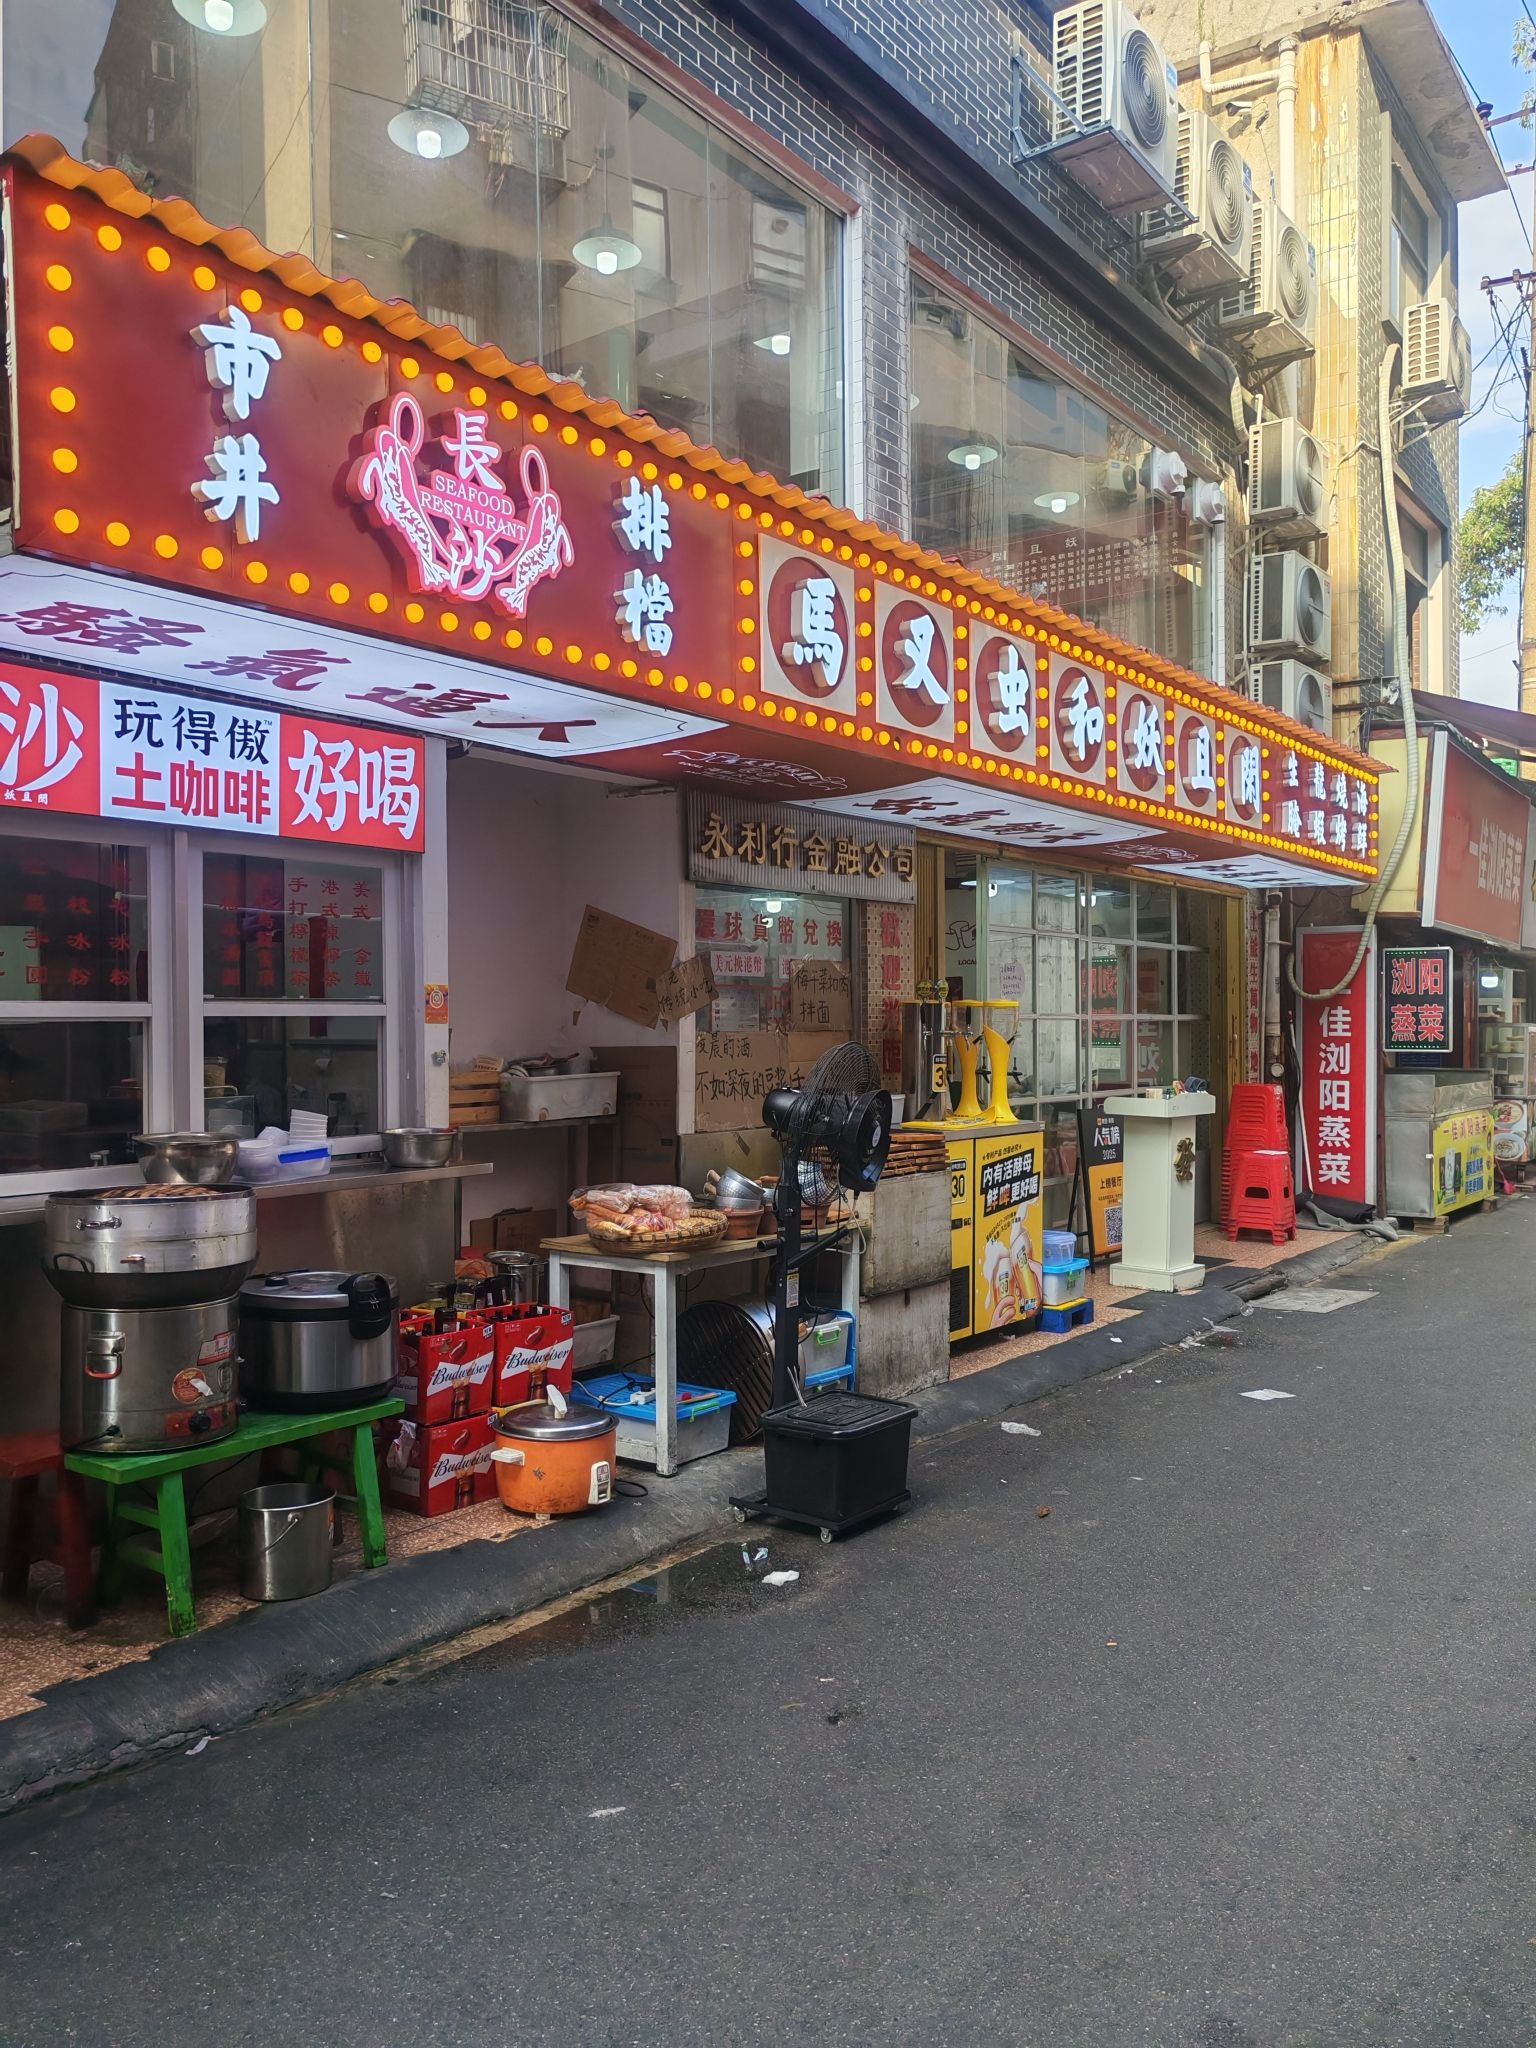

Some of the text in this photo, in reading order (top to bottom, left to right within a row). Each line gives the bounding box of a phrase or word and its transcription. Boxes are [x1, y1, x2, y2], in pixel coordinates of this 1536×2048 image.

[191, 305, 281, 542] 市井
[446, 412, 503, 489] 長
[435, 475, 513, 515] SEAFOOD
[420, 491, 527, 541] RESTAURANT
[613, 476, 674, 656] 排檔
[0, 601, 596, 744] 騷氣逼人
[0, 681, 84, 791] 沙
[113, 699, 270, 765] 玩得傲
[112, 752, 272, 825] 土咖啡
[288, 730, 420, 840] 好喝
[701, 812, 915, 883] 永利行金融公司
[1391, 958, 1444, 995] 浏阳
[800, 1000, 830, 1024] 拌面
[1391, 1004, 1444, 1042] 蒸菜
[1094, 1126, 1120, 1147] 人气榜
[952, 1173, 966, 1199] 30
[982, 1153, 1033, 1189] 内有活酵母
[986, 1174, 1039, 1212] 鲜啤更好喝
[431, 1362, 490, 1386] Budweiser
[505, 1348, 569, 1370] Budweiser
[433, 1451, 492, 1478] Budweise
